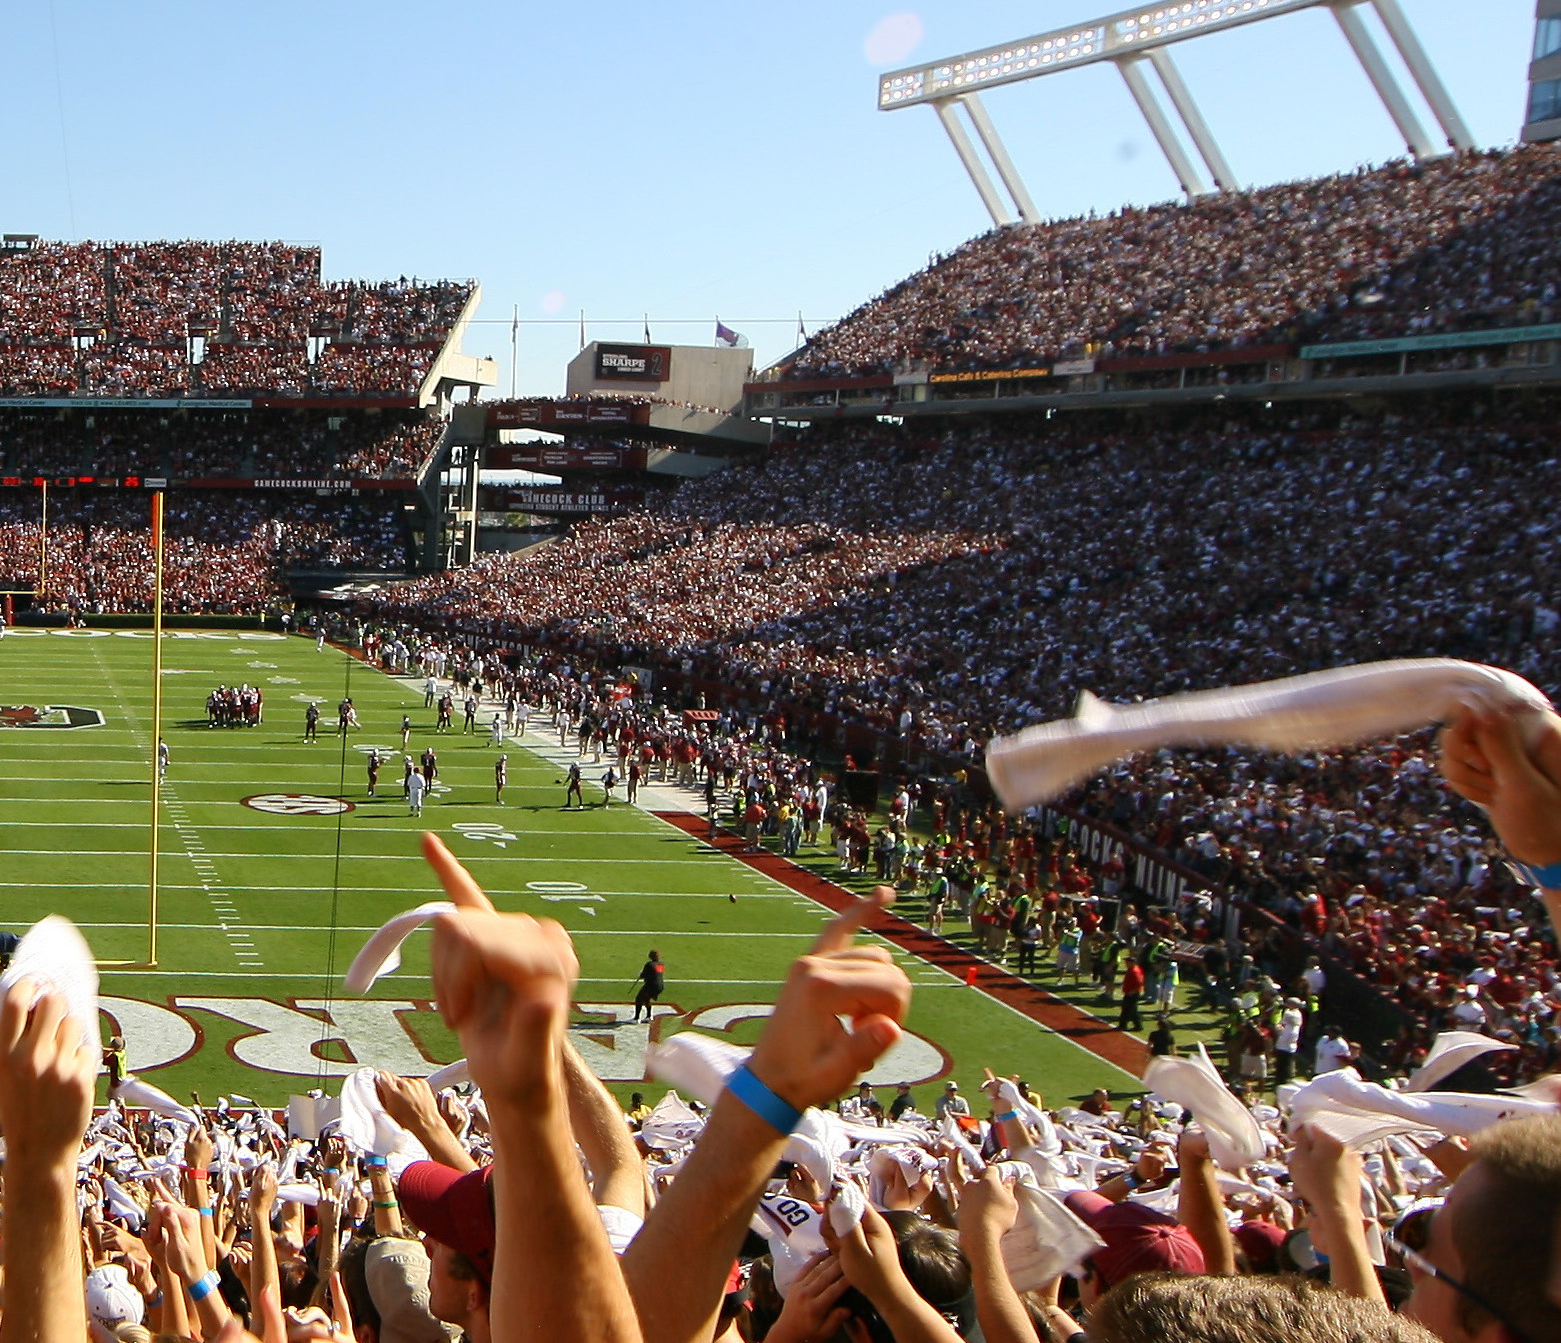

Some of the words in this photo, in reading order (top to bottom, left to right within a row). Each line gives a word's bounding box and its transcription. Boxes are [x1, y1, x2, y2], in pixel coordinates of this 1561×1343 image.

[602, 358, 646, 367] SHARPE
[651, 352, 663, 375] 2
[254, 479, 352, 488] GAMECOCKSONLINE.COM
[578, 493, 605, 505] CLUB
